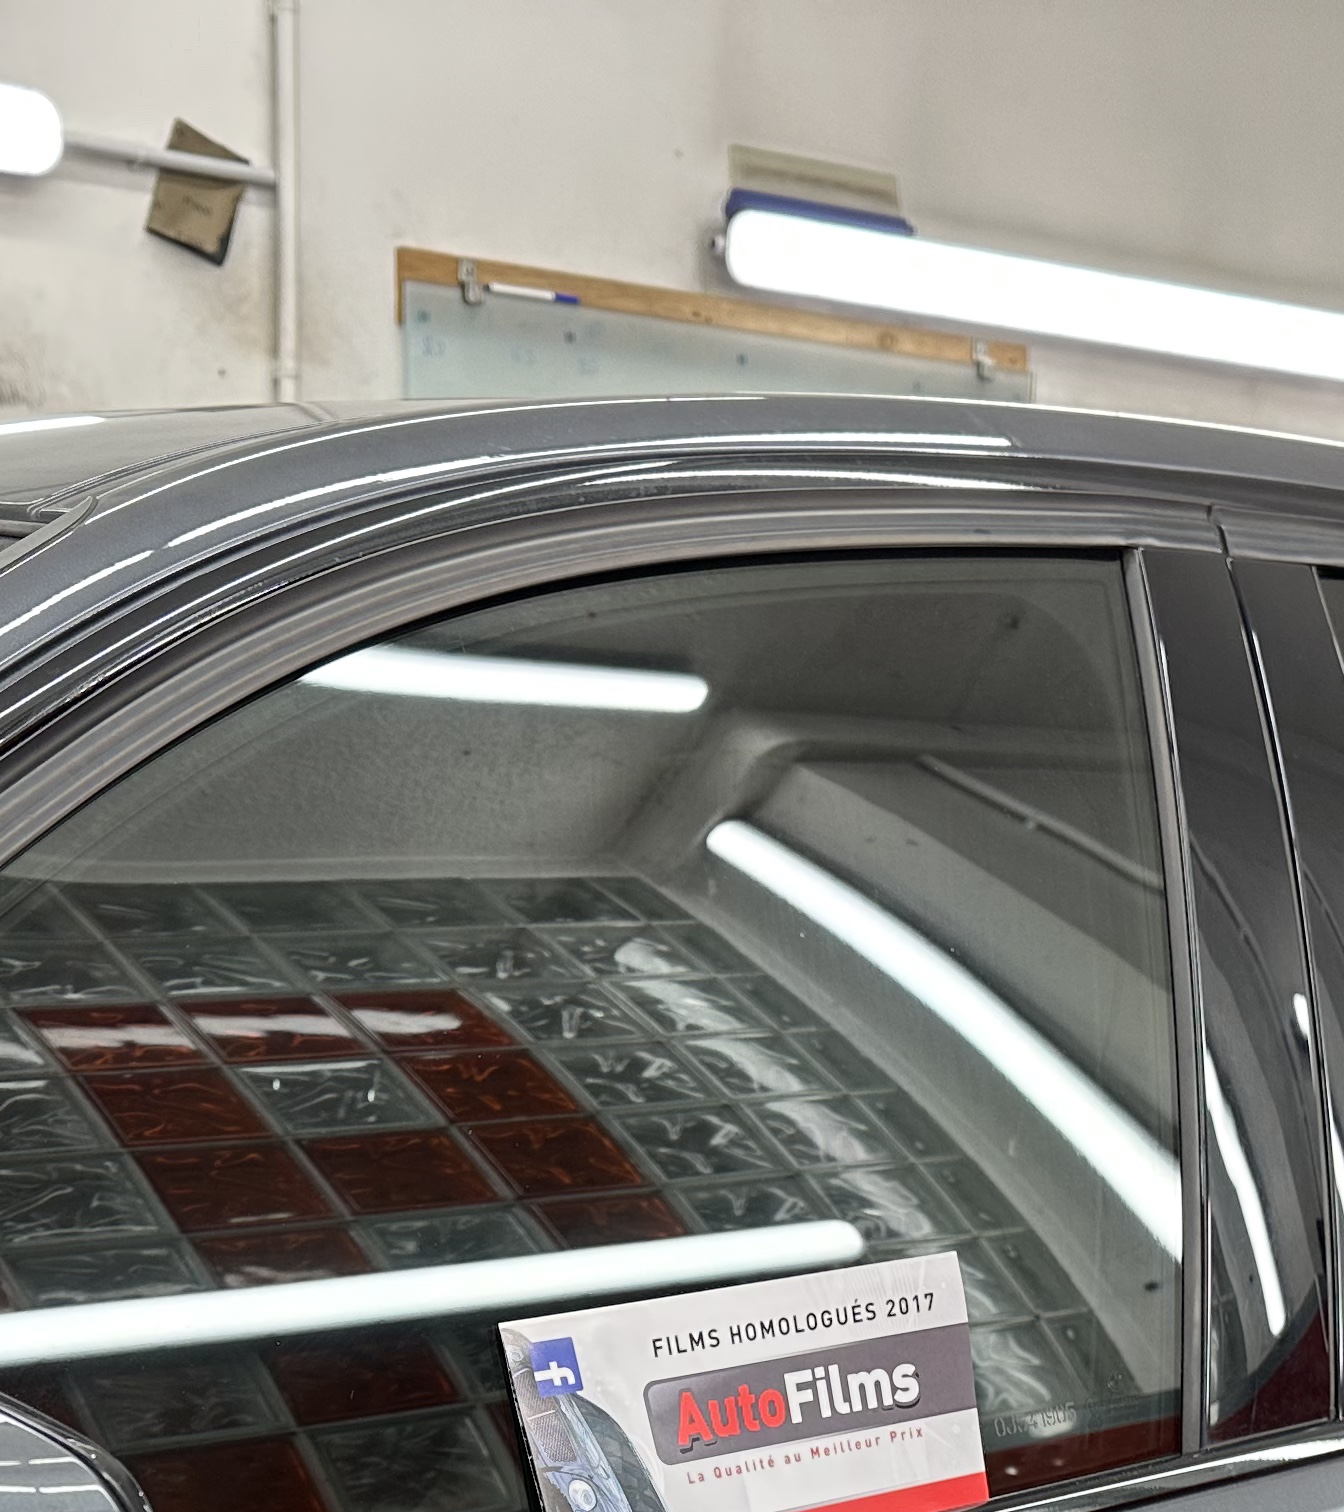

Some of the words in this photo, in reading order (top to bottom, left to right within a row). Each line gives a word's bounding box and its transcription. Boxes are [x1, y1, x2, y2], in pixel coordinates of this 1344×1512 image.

[651, 1328, 721, 1358] FILMS
[729, 1298, 877, 1344] HOMOLOGUÉS
[886, 1292, 935, 1318] 2017
[677, 1363, 921, 1450] AutoFilms
[687, 1470, 705, 1484] La
[713, 1455, 775, 1479] Qualité
[784, 1453, 802, 1465] au
[810, 1434, 882, 1460] Meilleur
[889, 1426, 923, 1444] Prix
